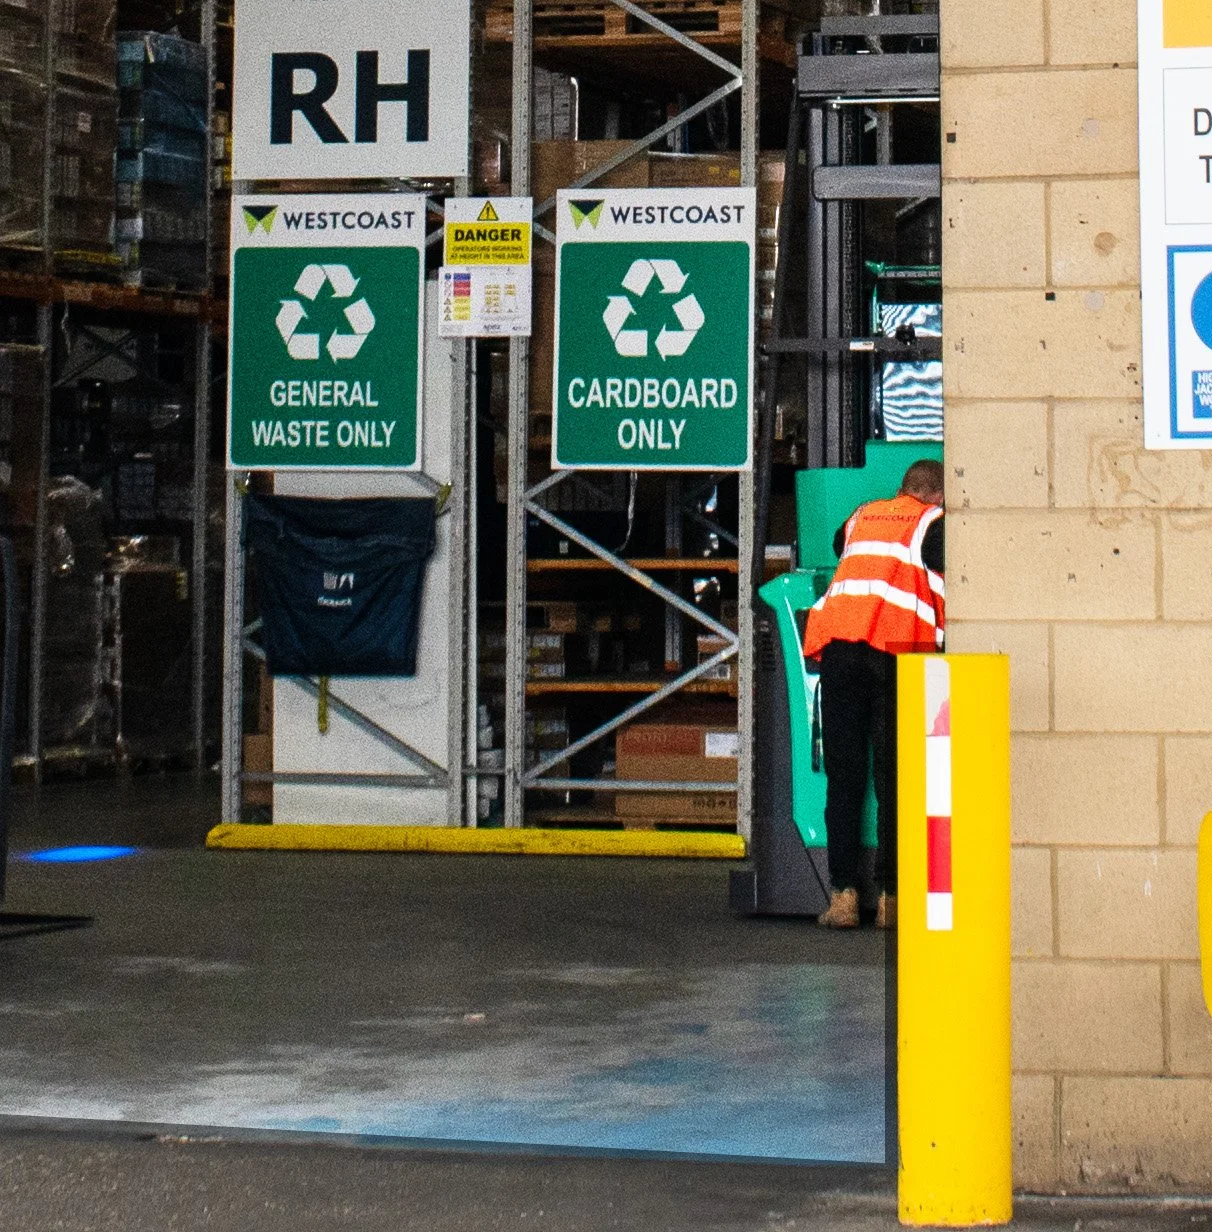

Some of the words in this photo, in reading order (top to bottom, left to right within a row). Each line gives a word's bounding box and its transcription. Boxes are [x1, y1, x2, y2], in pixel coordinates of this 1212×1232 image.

[270, 49, 431, 145] RH
[283, 211, 416, 230] WESTCOAST
[610, 204, 745, 225] WESTCOAST
[455, 229, 521, 241] DANGER
[269, 380, 379, 407] GENERAL
[567, 377, 737, 409] CARDBOARD
[251, 421, 329, 448] WASTE
[337, 419, 396, 447] ONLY
[617, 419, 686, 451] ONLY
